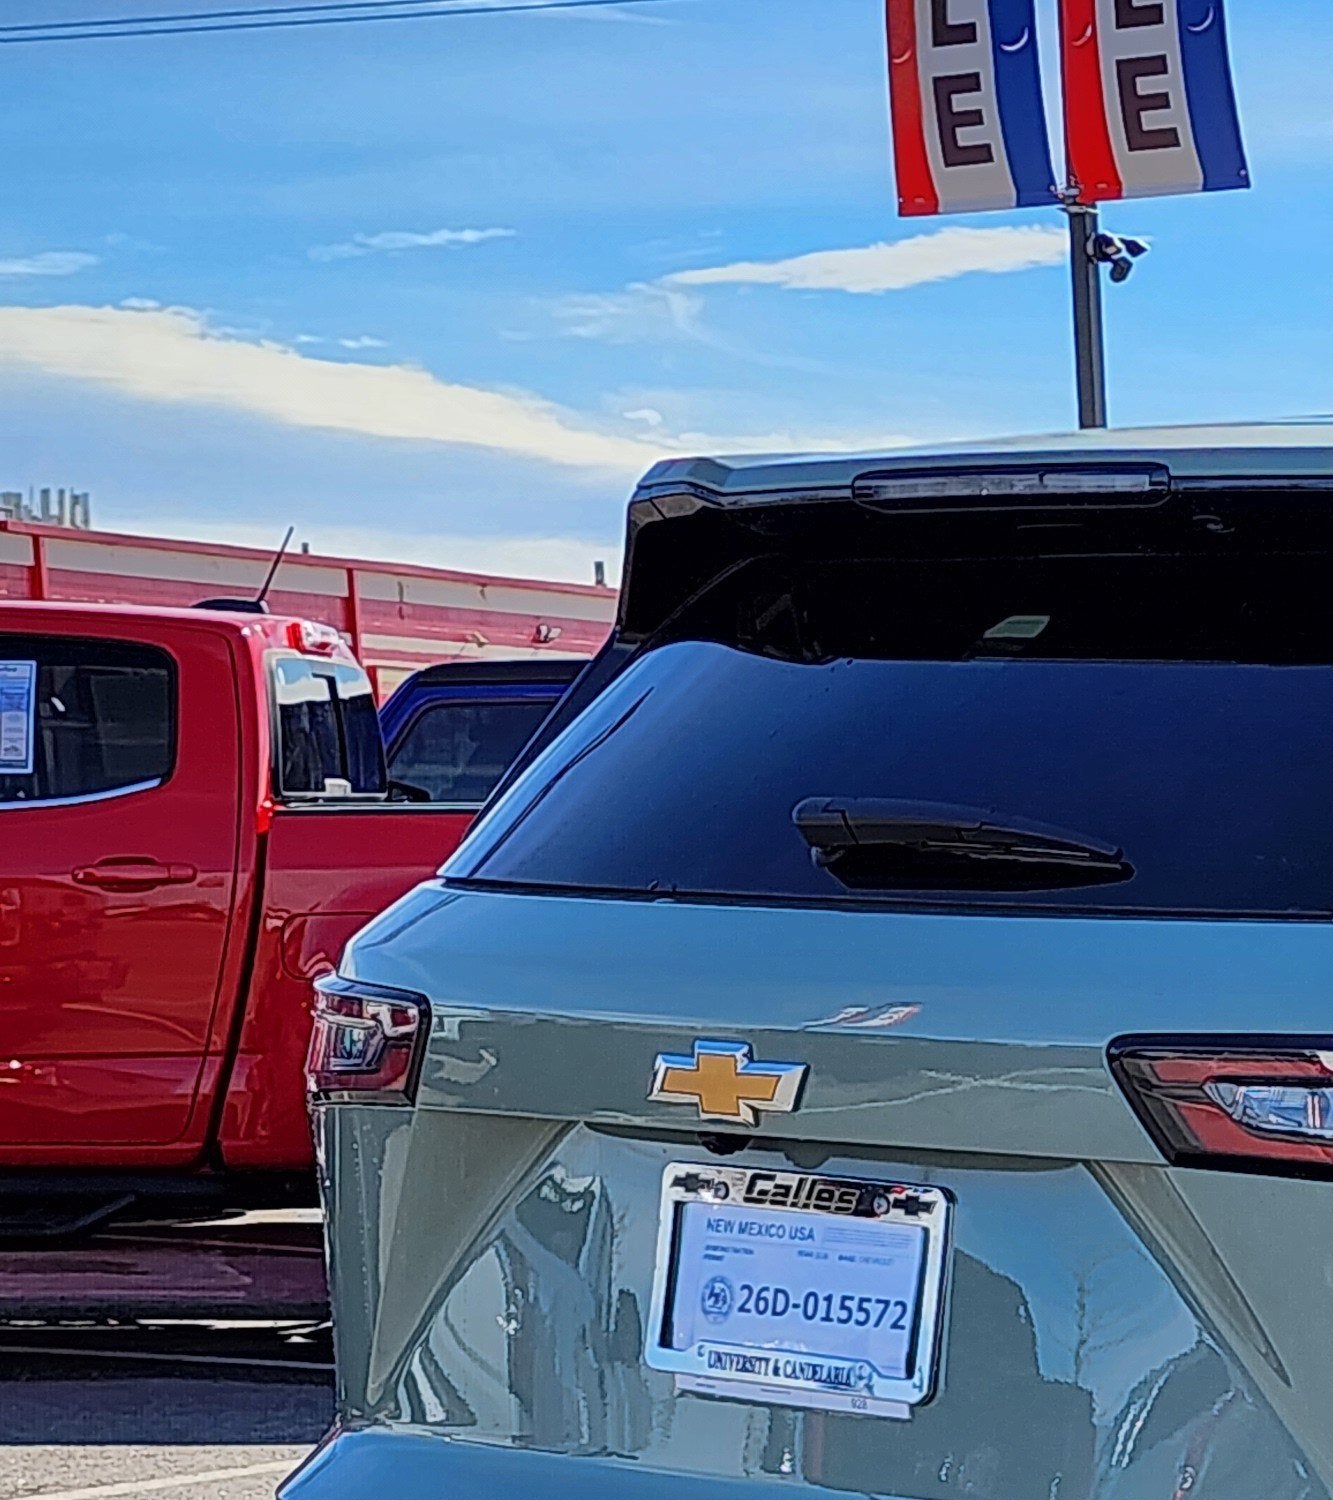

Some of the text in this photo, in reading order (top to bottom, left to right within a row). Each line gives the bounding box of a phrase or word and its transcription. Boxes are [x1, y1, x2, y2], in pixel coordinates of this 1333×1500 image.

[743, 1172, 859, 1215] Galles
[706, 1217, 735, 1235] NEW
[738, 1221, 786, 1239] MEXICO
[789, 1226, 816, 1242] USA
[737, 1283, 908, 1331] 26D-015572
[707, 1350, 855, 1387] UNIVERSITY & CANDELARIA
